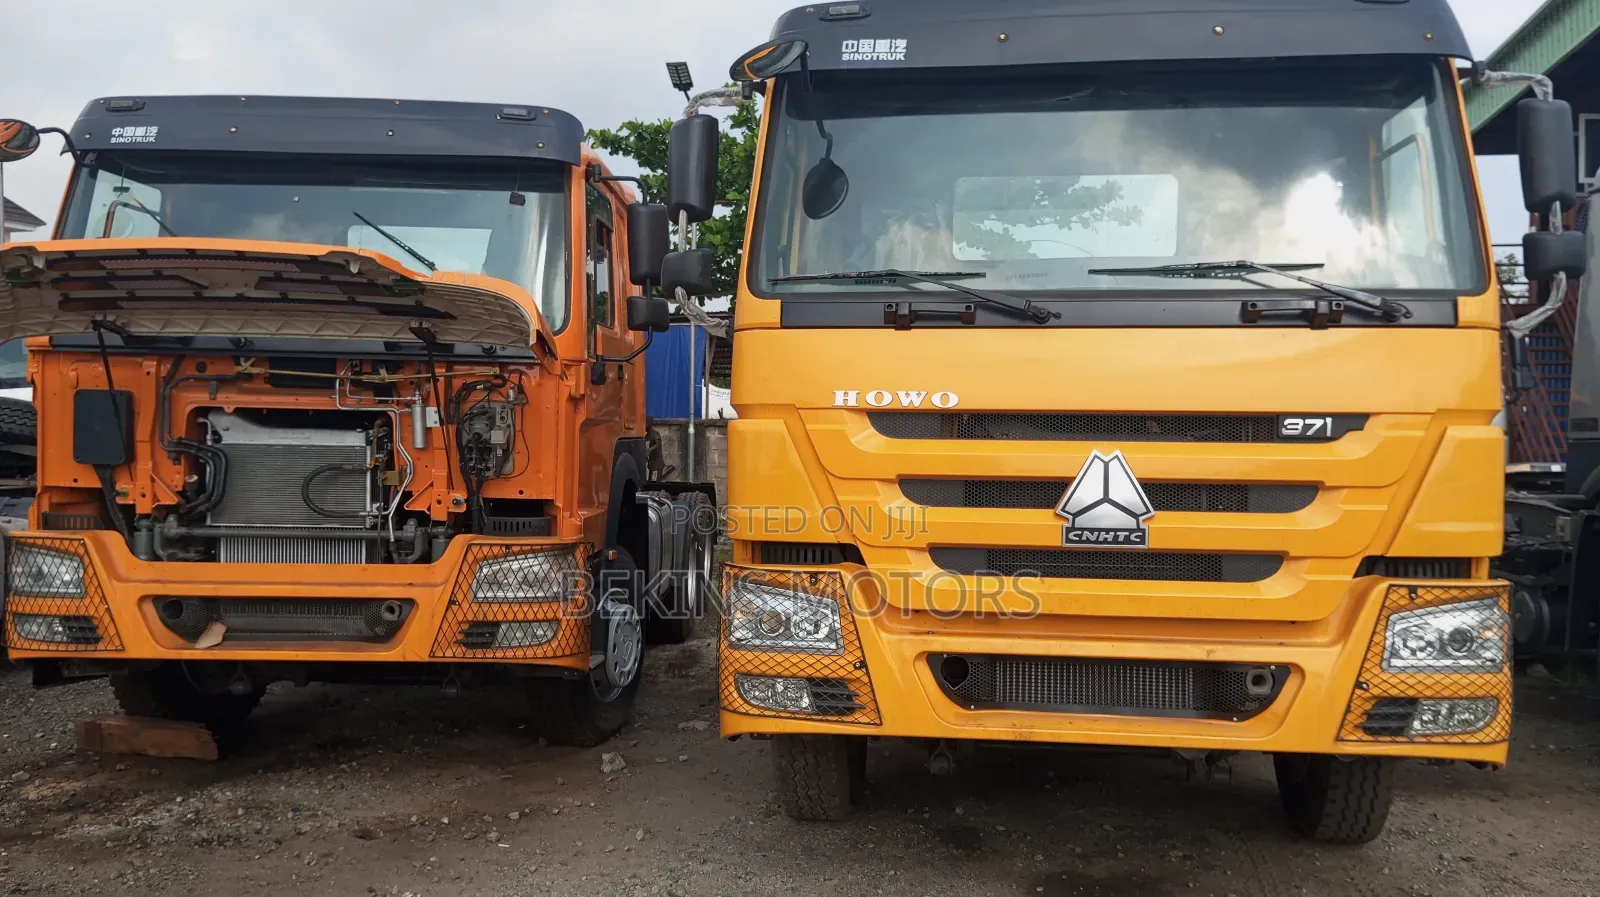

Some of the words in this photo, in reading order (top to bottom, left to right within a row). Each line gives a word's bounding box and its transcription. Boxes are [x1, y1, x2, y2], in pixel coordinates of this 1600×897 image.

[841, 39, 908, 53] 中国重汽
[841, 52, 906, 61] SINOTRUK
[110, 136, 156, 144] SINOTRUK
[832, 389, 960, 408] HOWO
[1281, 416, 1333, 437] 371
[1067, 530, 1143, 542] CNHTC
